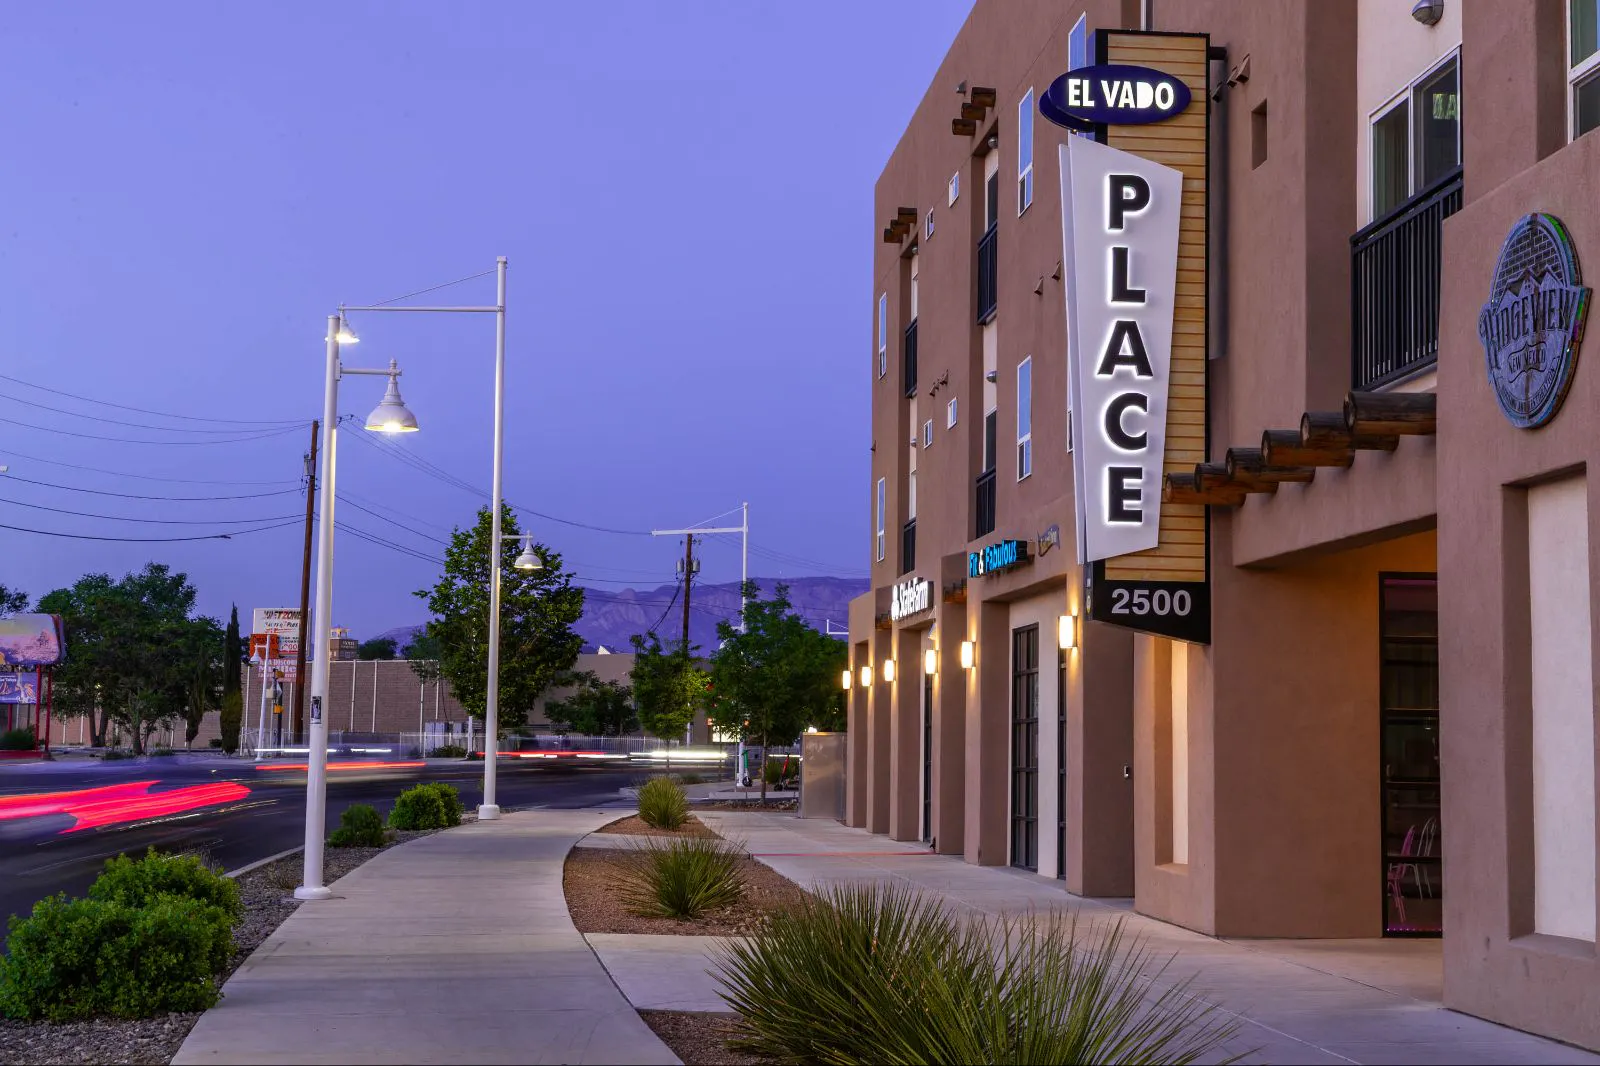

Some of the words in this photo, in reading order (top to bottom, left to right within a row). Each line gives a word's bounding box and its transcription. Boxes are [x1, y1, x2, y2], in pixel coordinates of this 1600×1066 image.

[1068, 78, 1095, 107] EL
[1101, 80, 1175, 110] VADO
[1096, 174, 1154, 524] PLACE
[1508, 355, 1522, 374] NEW
[969, 553, 978, 578] Fit
[978, 548, 984, 576] &
[985, 539, 1017, 573] Fabulous
[1111, 588, 1192, 617] 2500
